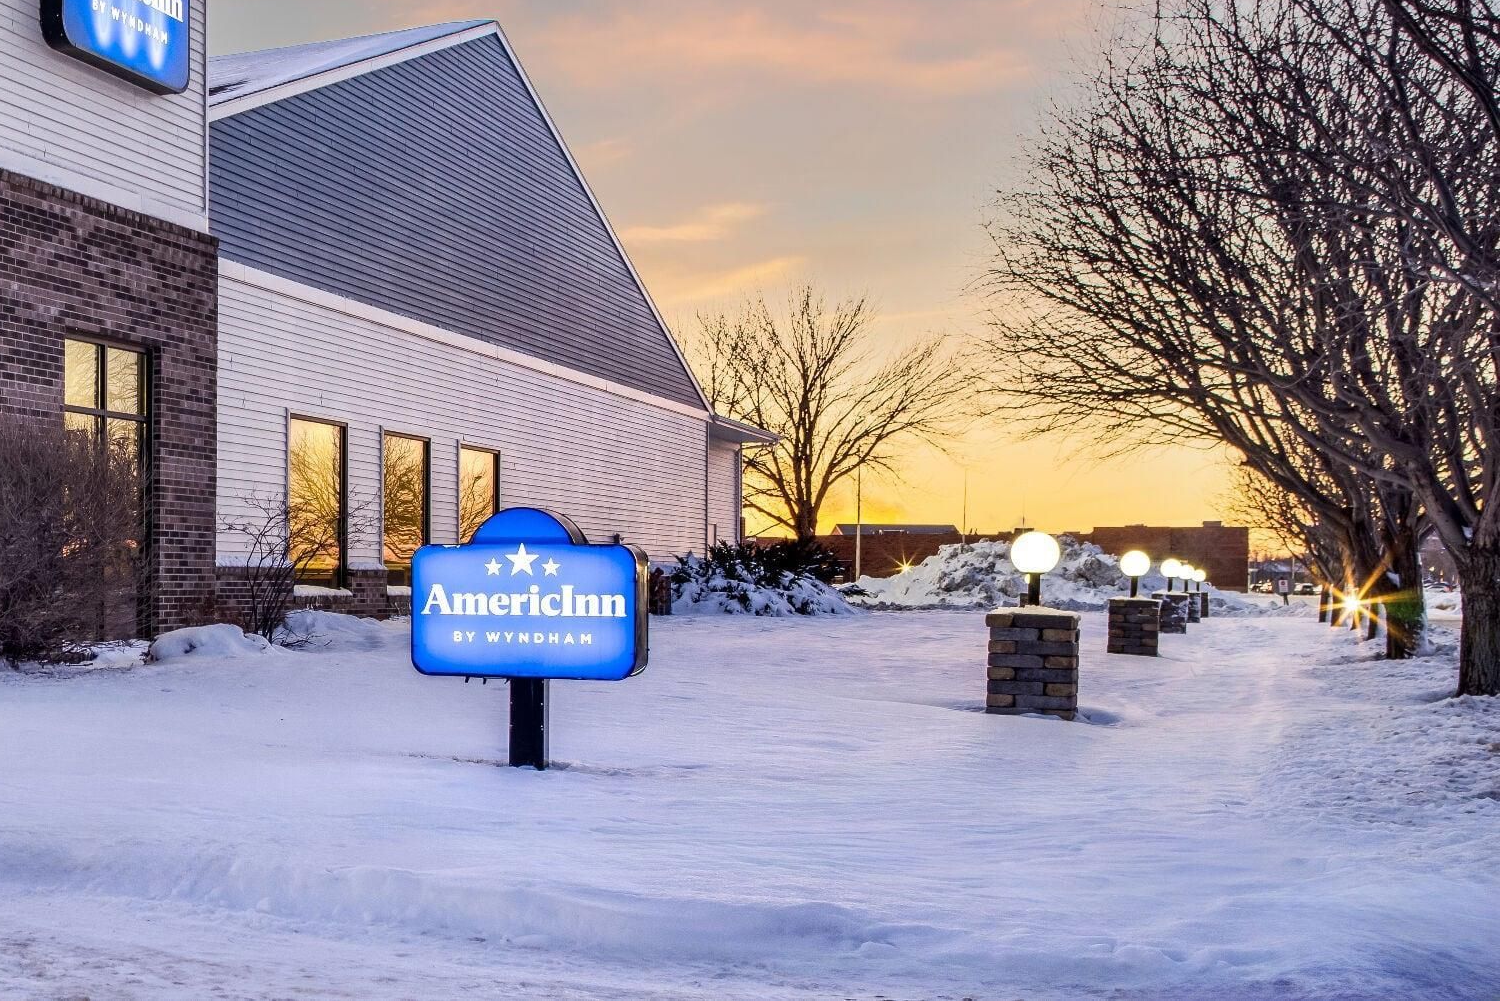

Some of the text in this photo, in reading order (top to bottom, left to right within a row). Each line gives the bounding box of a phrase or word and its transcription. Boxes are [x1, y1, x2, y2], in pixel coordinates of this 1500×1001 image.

[111, 7, 169, 45] WYNDHAM
[421, 583, 628, 618] AmericInn
[453, 630, 593, 645] BY WYNDHAM
